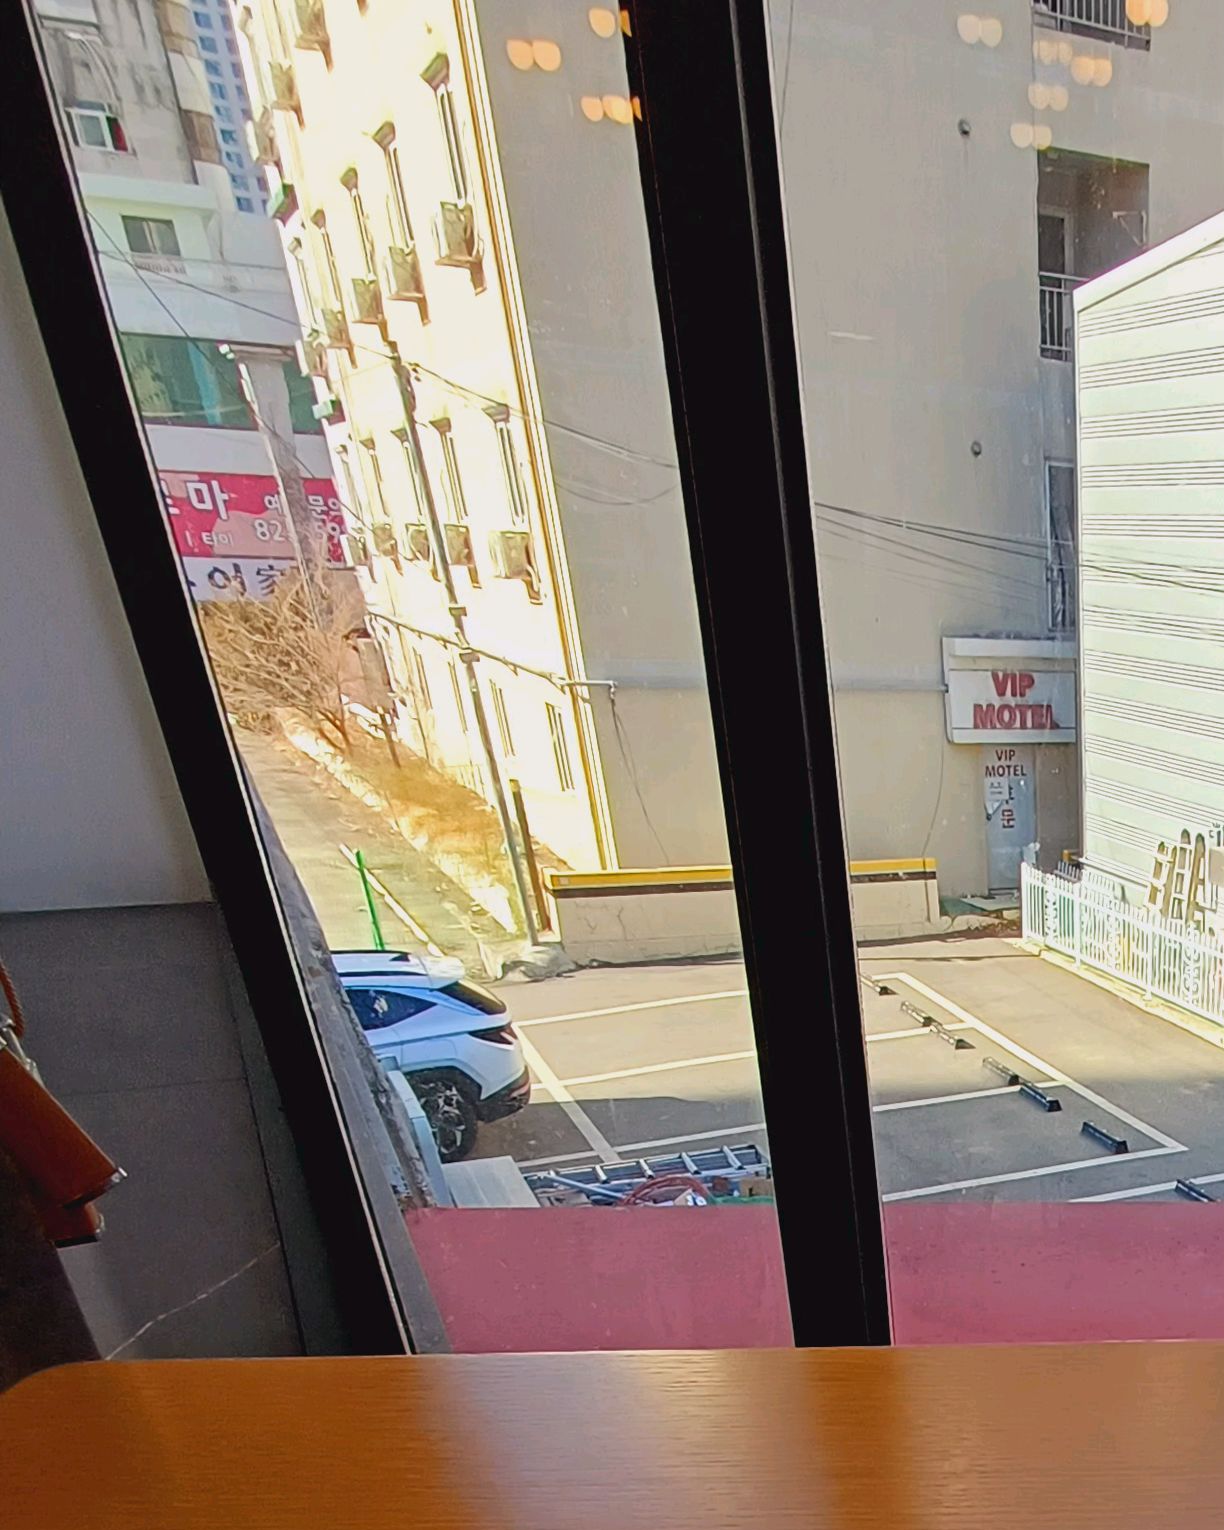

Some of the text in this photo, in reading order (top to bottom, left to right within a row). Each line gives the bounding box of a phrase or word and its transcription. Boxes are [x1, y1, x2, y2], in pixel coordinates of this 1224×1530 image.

[991, 671, 1035, 698] VIP
[973, 703, 1061, 730] MOTEL
[995, 750, 1016, 762] VIP
[985, 765, 1027, 778] MOTEL
